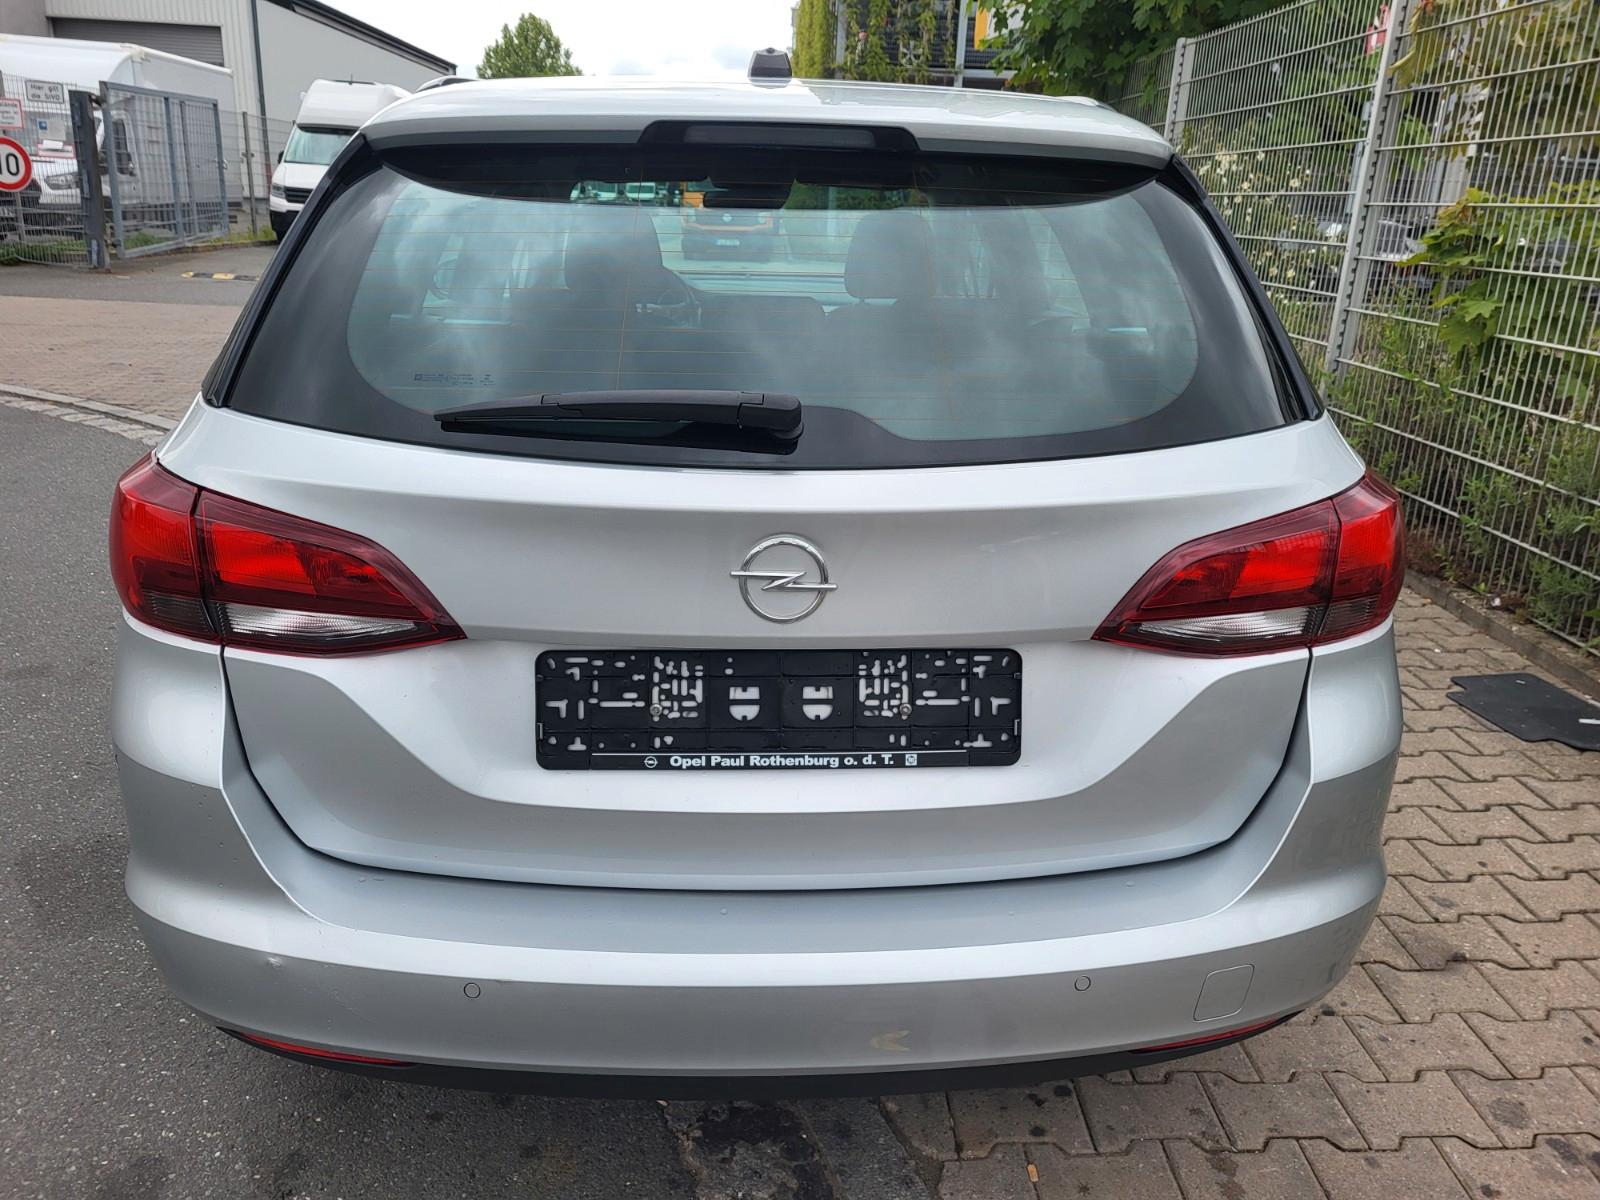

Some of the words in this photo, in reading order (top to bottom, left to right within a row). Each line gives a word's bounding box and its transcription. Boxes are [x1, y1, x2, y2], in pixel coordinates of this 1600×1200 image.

[670, 755, 706, 769] Opel
[710, 755, 745, 767] Paul
[749, 755, 840, 768] Rothenburg
[843, 756, 858, 766] o.
[862, 754, 877, 765] d.
[881, 753, 895, 765] T.
